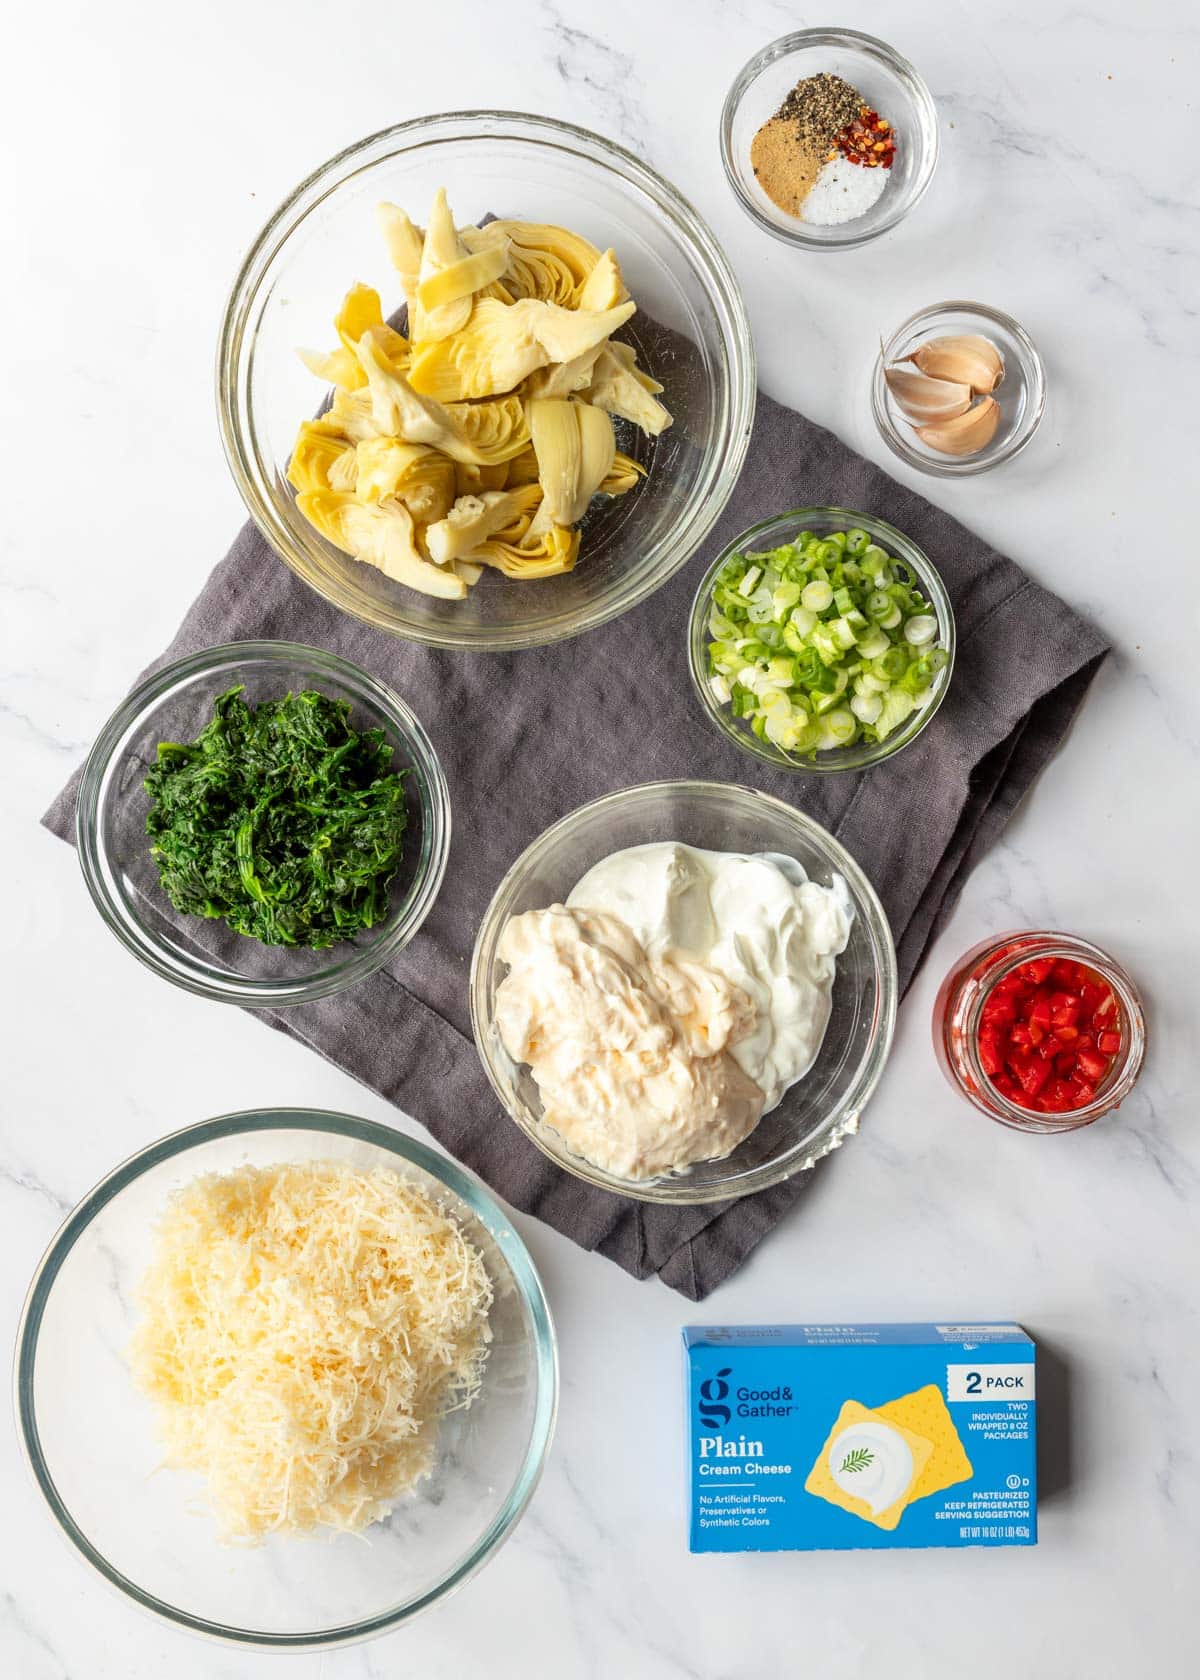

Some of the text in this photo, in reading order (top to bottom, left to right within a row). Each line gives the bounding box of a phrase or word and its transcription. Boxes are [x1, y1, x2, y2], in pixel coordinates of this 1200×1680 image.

[966, 1372, 1024, 1394] 2 PACK
[1008, 1403, 1028, 1411] TWO
[972, 1413, 1028, 1422] INDIVIDUALLY
[968, 1423, 1008, 1431] WRAPPED
[1016, 1422, 1028, 1430] OZ
[984, 1432, 1028, 1440] PACKAGES
[699, 1435, 764, 1458] Plain
[699, 1463, 792, 1476] Cream Cheese
[700, 1494, 786, 1504] No Artificial Flavors,
[972, 1491, 1029, 1500] PASTEURIZED
[944, 1501, 1029, 1510] KEEP REFRIGERATED
[700, 1506, 767, 1516] Preservatives or
[935, 1511, 1029, 1520] SERVING SUGGESTION
[700, 1517, 770, 1528] Synthetic Colors
[960, 1527, 970, 1538] NET
[971, 1527, 981, 1538] WT
[989, 1526, 998, 1538] OZ
